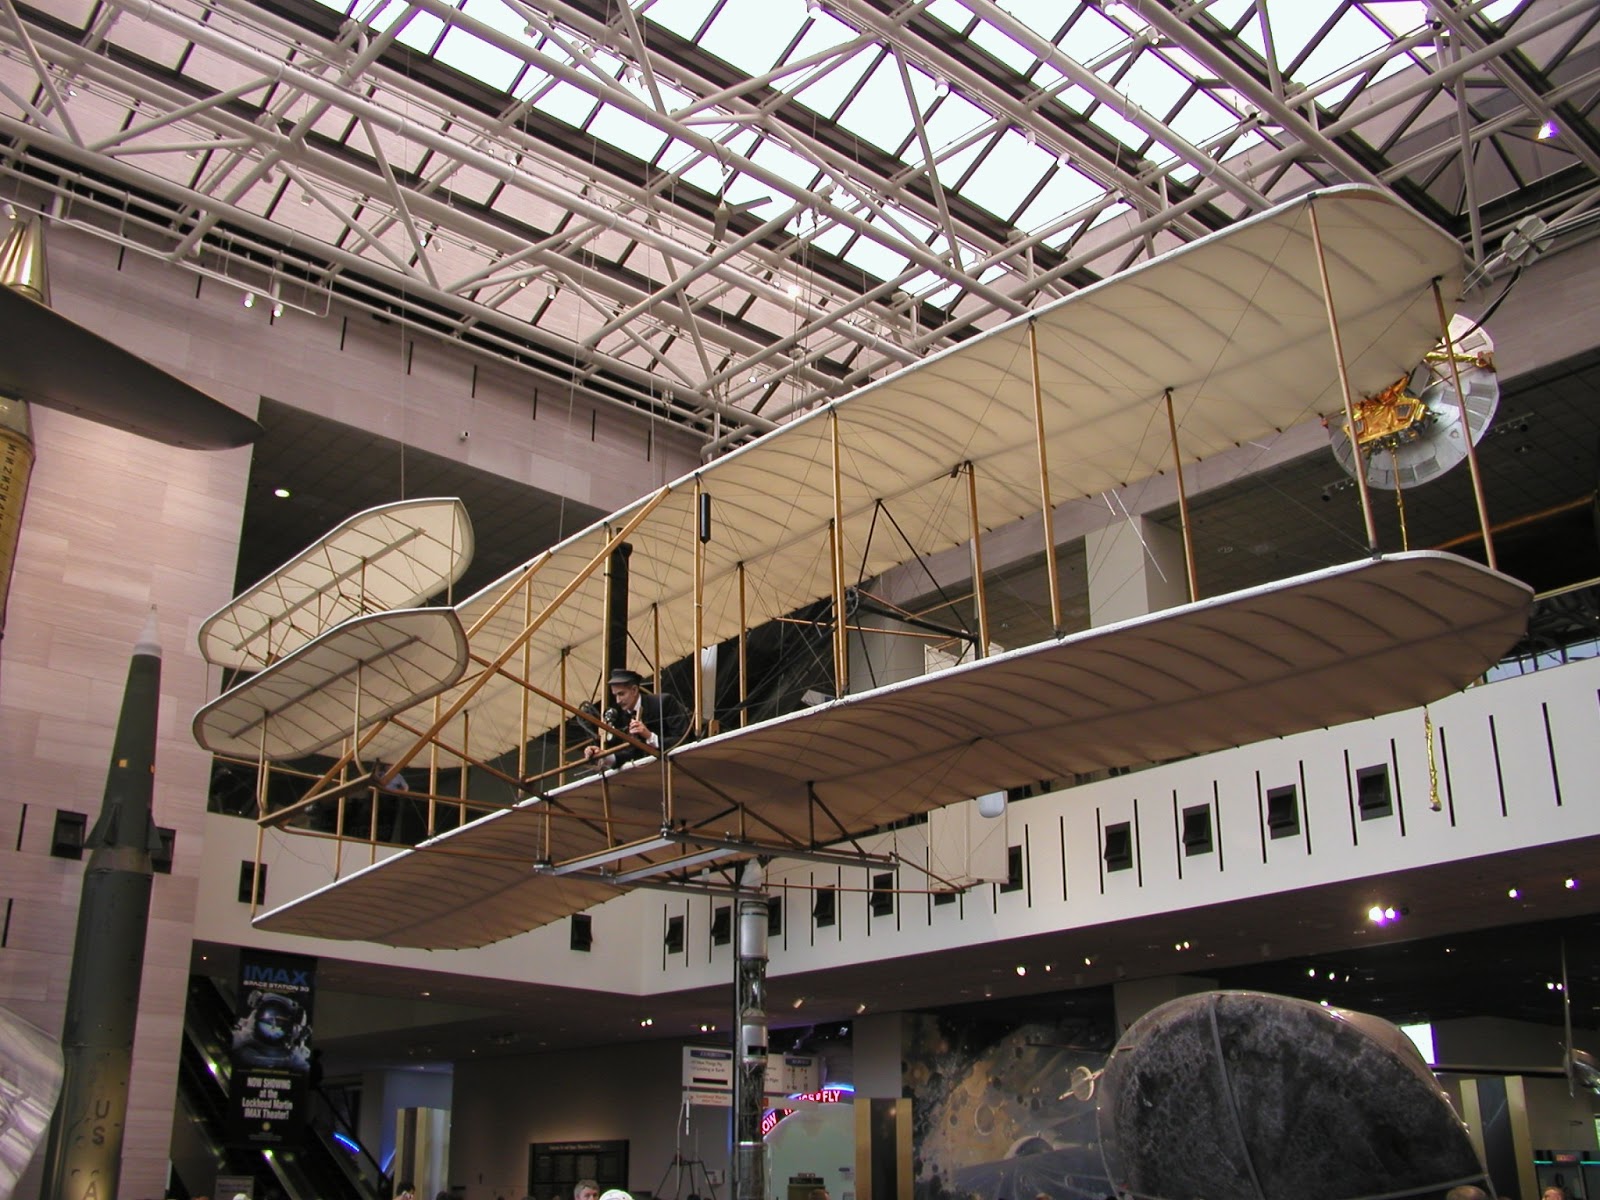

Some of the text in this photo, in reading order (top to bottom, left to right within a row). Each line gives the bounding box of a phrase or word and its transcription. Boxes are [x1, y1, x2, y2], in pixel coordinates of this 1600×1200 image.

[244, 964, 306, 984] IMAX
[243, 980, 268, 988] SPACE
[268, 982, 299, 991] STATION
[247, 1077, 291, 1089] NOW SHOWING
[259, 1089, 279, 1099] at the
[822, 1090, 841, 1103] FLY
[242, 1097, 293, 1110] Lockheed Martin
[244, 1107, 289, 1120] IMAX Theater!
